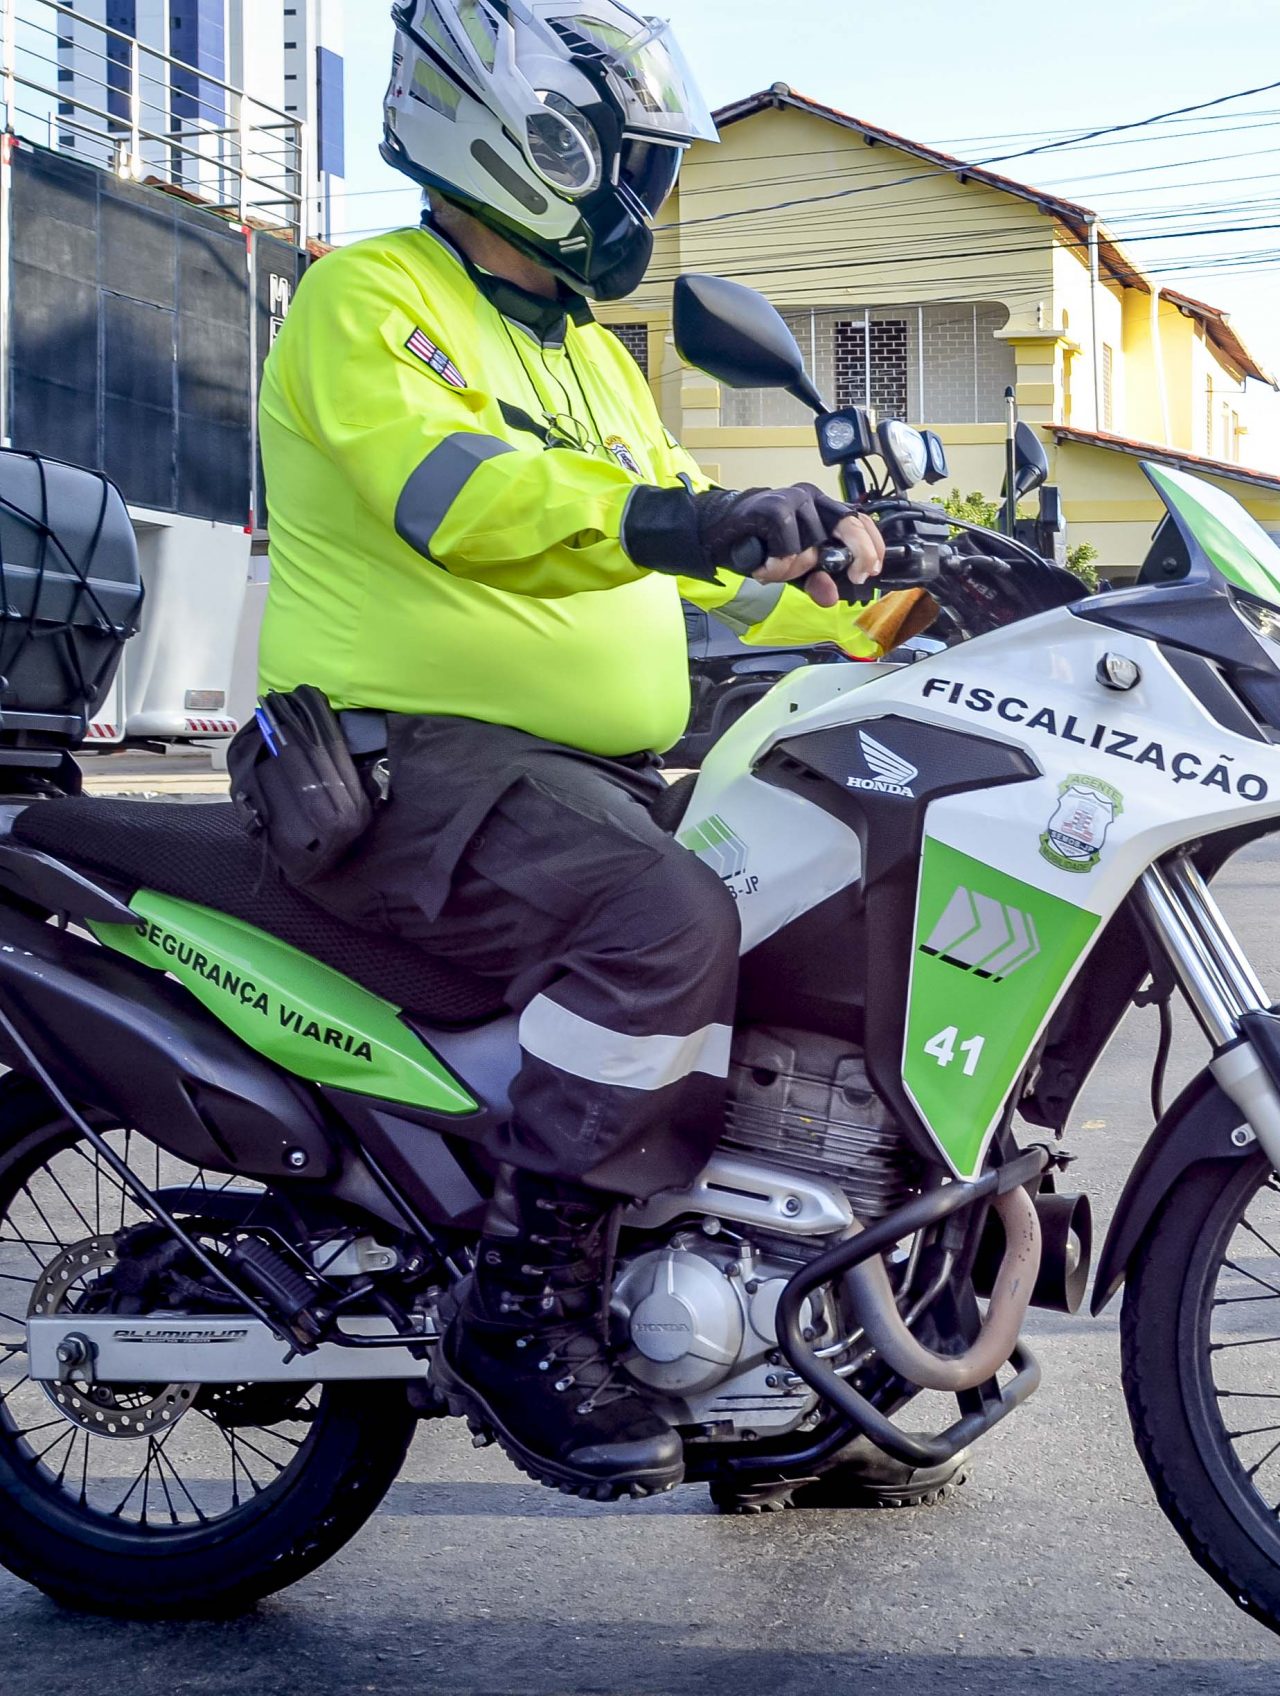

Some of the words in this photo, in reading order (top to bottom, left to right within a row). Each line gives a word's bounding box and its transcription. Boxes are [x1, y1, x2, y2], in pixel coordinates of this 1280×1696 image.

[270, 273, 292, 318] M
[922, 677, 1269, 801] FISCALIZAÇÃO
[846, 776, 915, 798] HONDA
[1070, 775, 1121, 802] AGENTE
[727, 875, 759, 900] B-JP
[134, 918, 269, 1016] SEGURANÇA
[278, 1004, 374, 1062] VIARIA
[923, 1025, 985, 1077] 41
[113, 1329, 249, 1338] ALUMINIUM
[633, 1323, 691, 1332] HONDA
